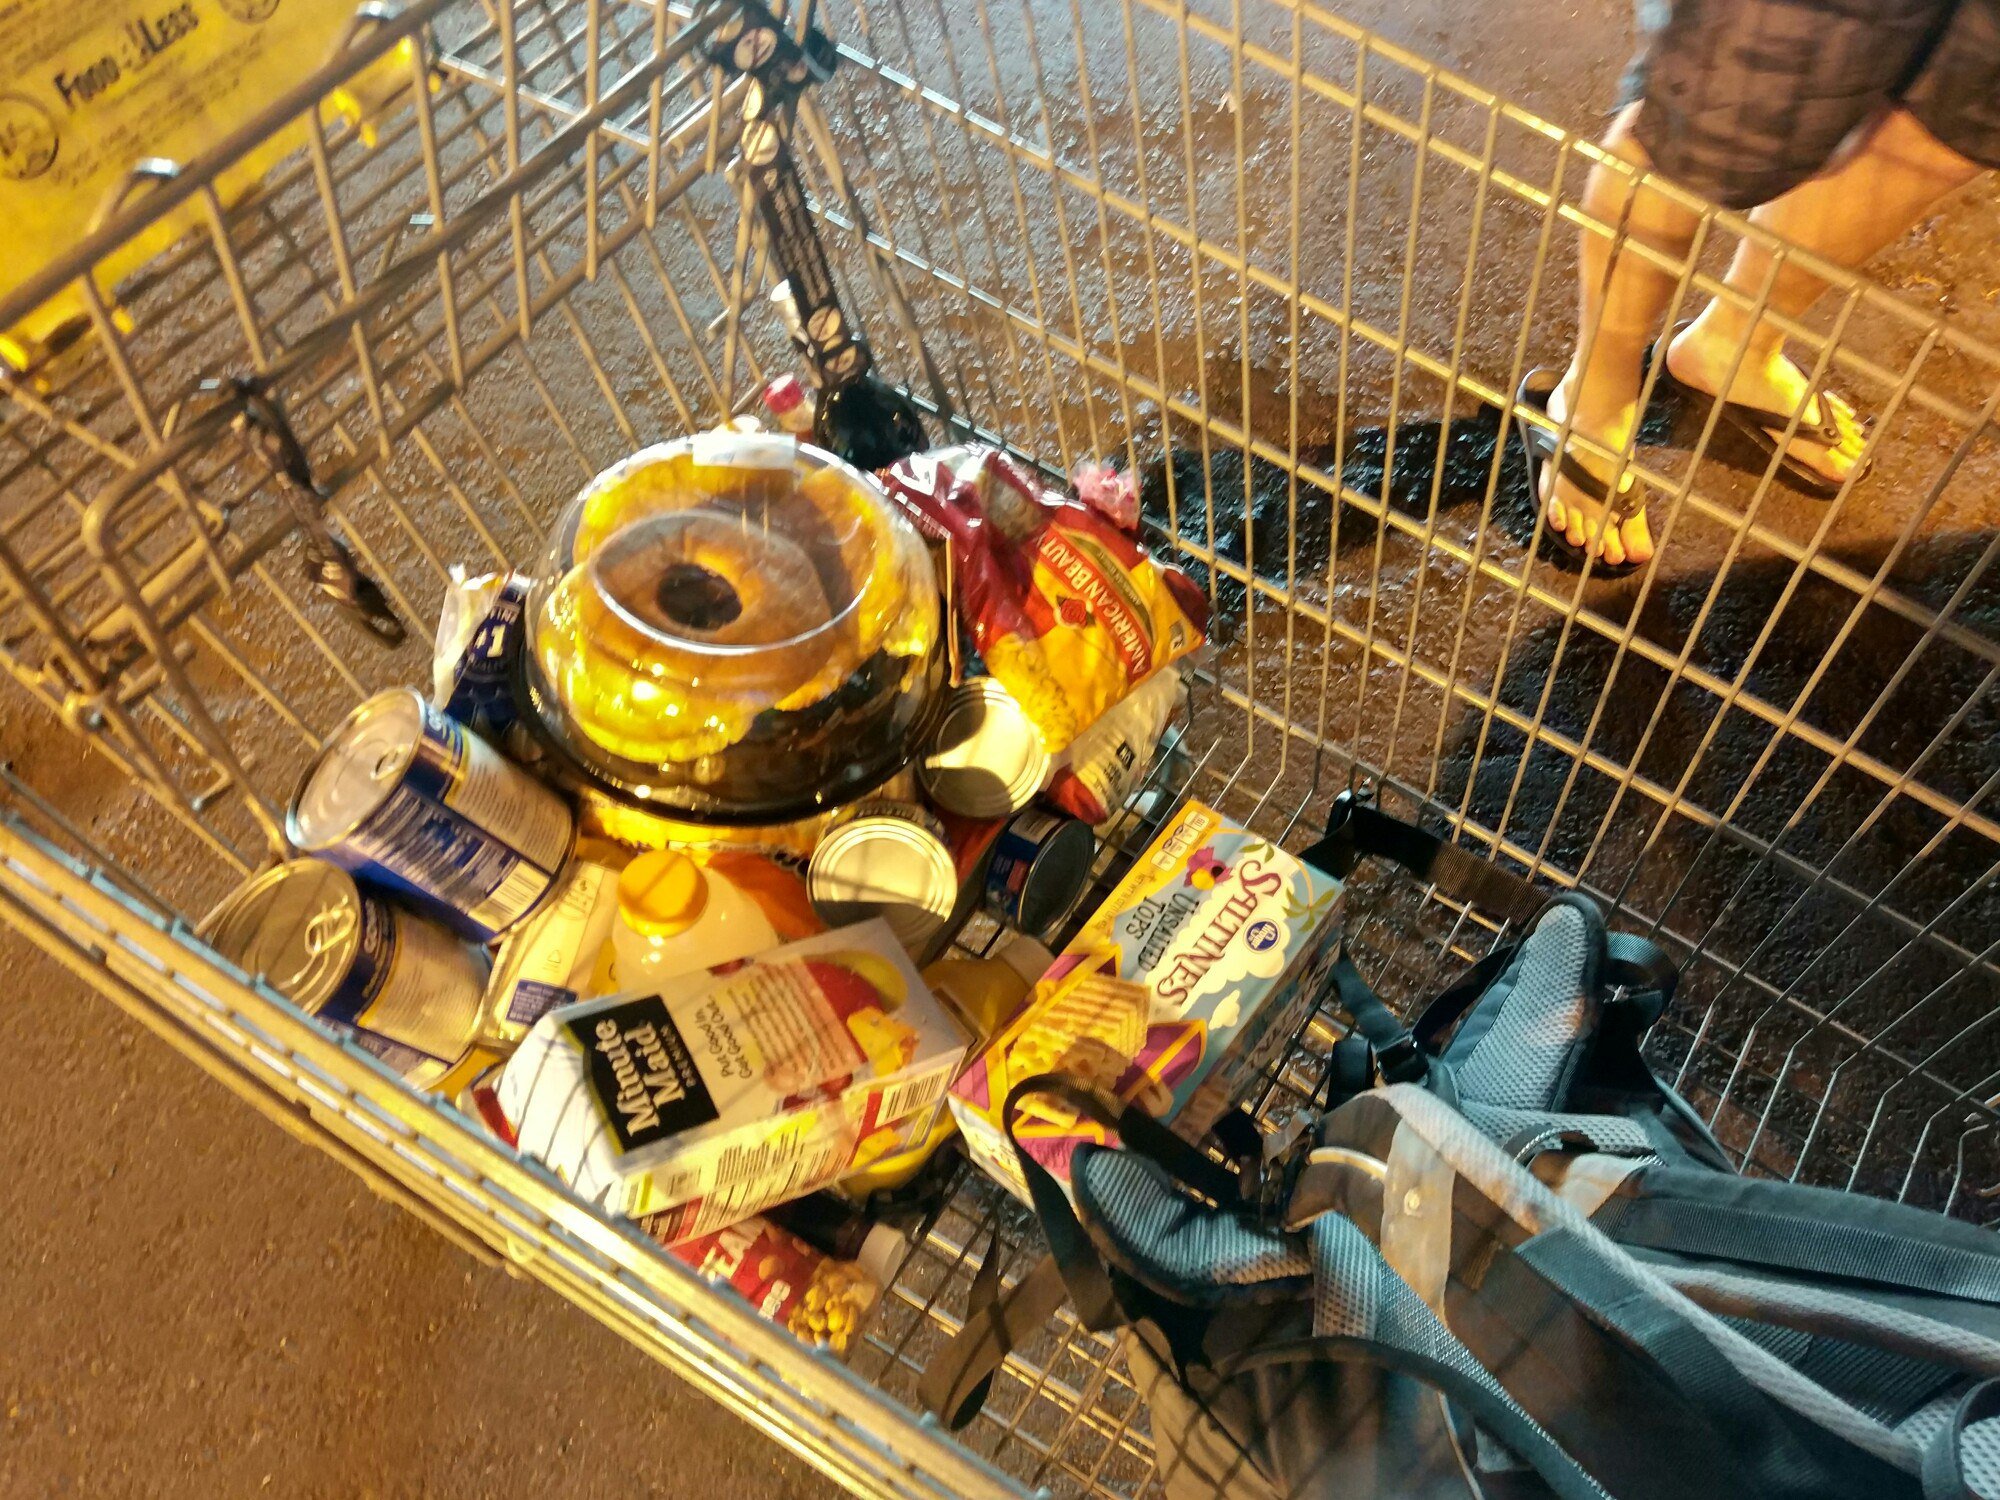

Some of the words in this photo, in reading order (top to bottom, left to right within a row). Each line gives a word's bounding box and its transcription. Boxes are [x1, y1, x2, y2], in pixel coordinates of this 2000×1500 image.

[1084, 579, 1146, 675] AMERICAN
[1125, 895, 1166, 941] TOPS
[1137, 891, 1200, 972] UNSALTED
[1157, 859, 1282, 1005] SALTINES
[623, 1021, 685, 1109] Maid
[699, 1022, 722, 1055] Good
[716, 1054, 734, 1078] Put
[717, 1022, 741, 1055] Good
[735, 1055, 753, 1079] Get
[595, 1018, 661, 1137] Minute
